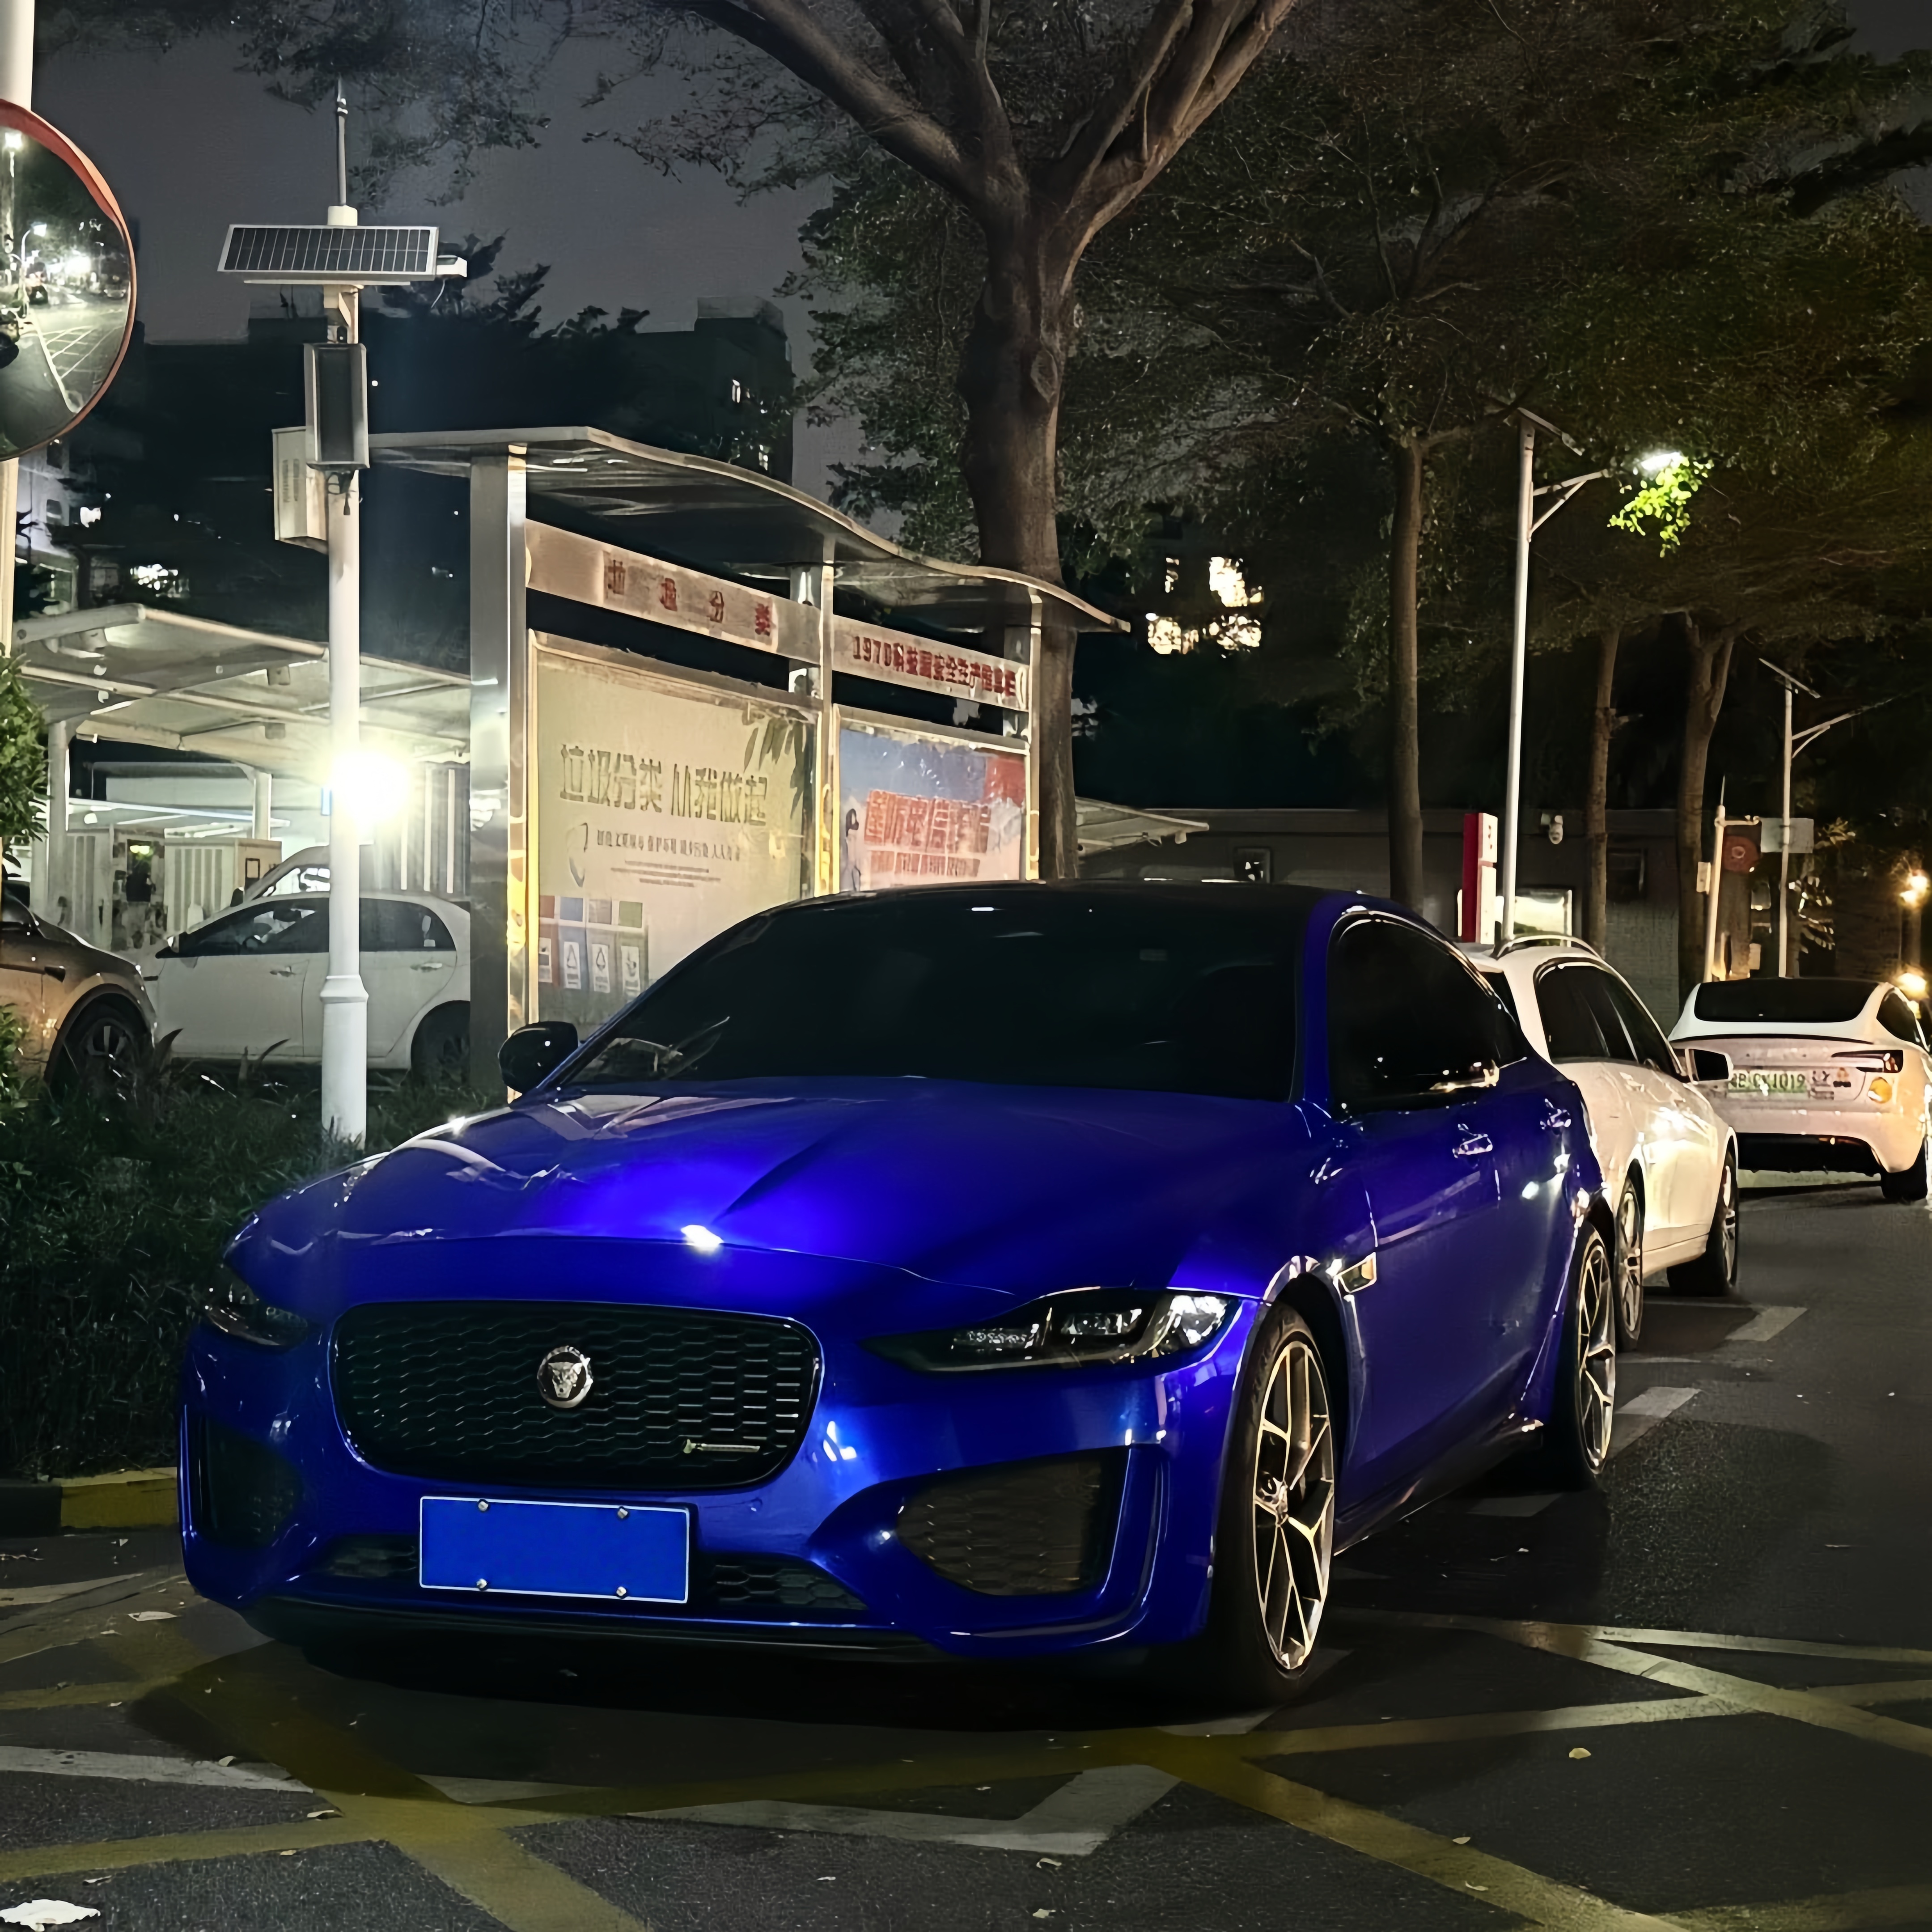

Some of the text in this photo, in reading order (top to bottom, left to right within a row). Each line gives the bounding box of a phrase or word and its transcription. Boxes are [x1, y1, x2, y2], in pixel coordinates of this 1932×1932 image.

[560, 744, 767, 826] 垃圾分类 从我做起
